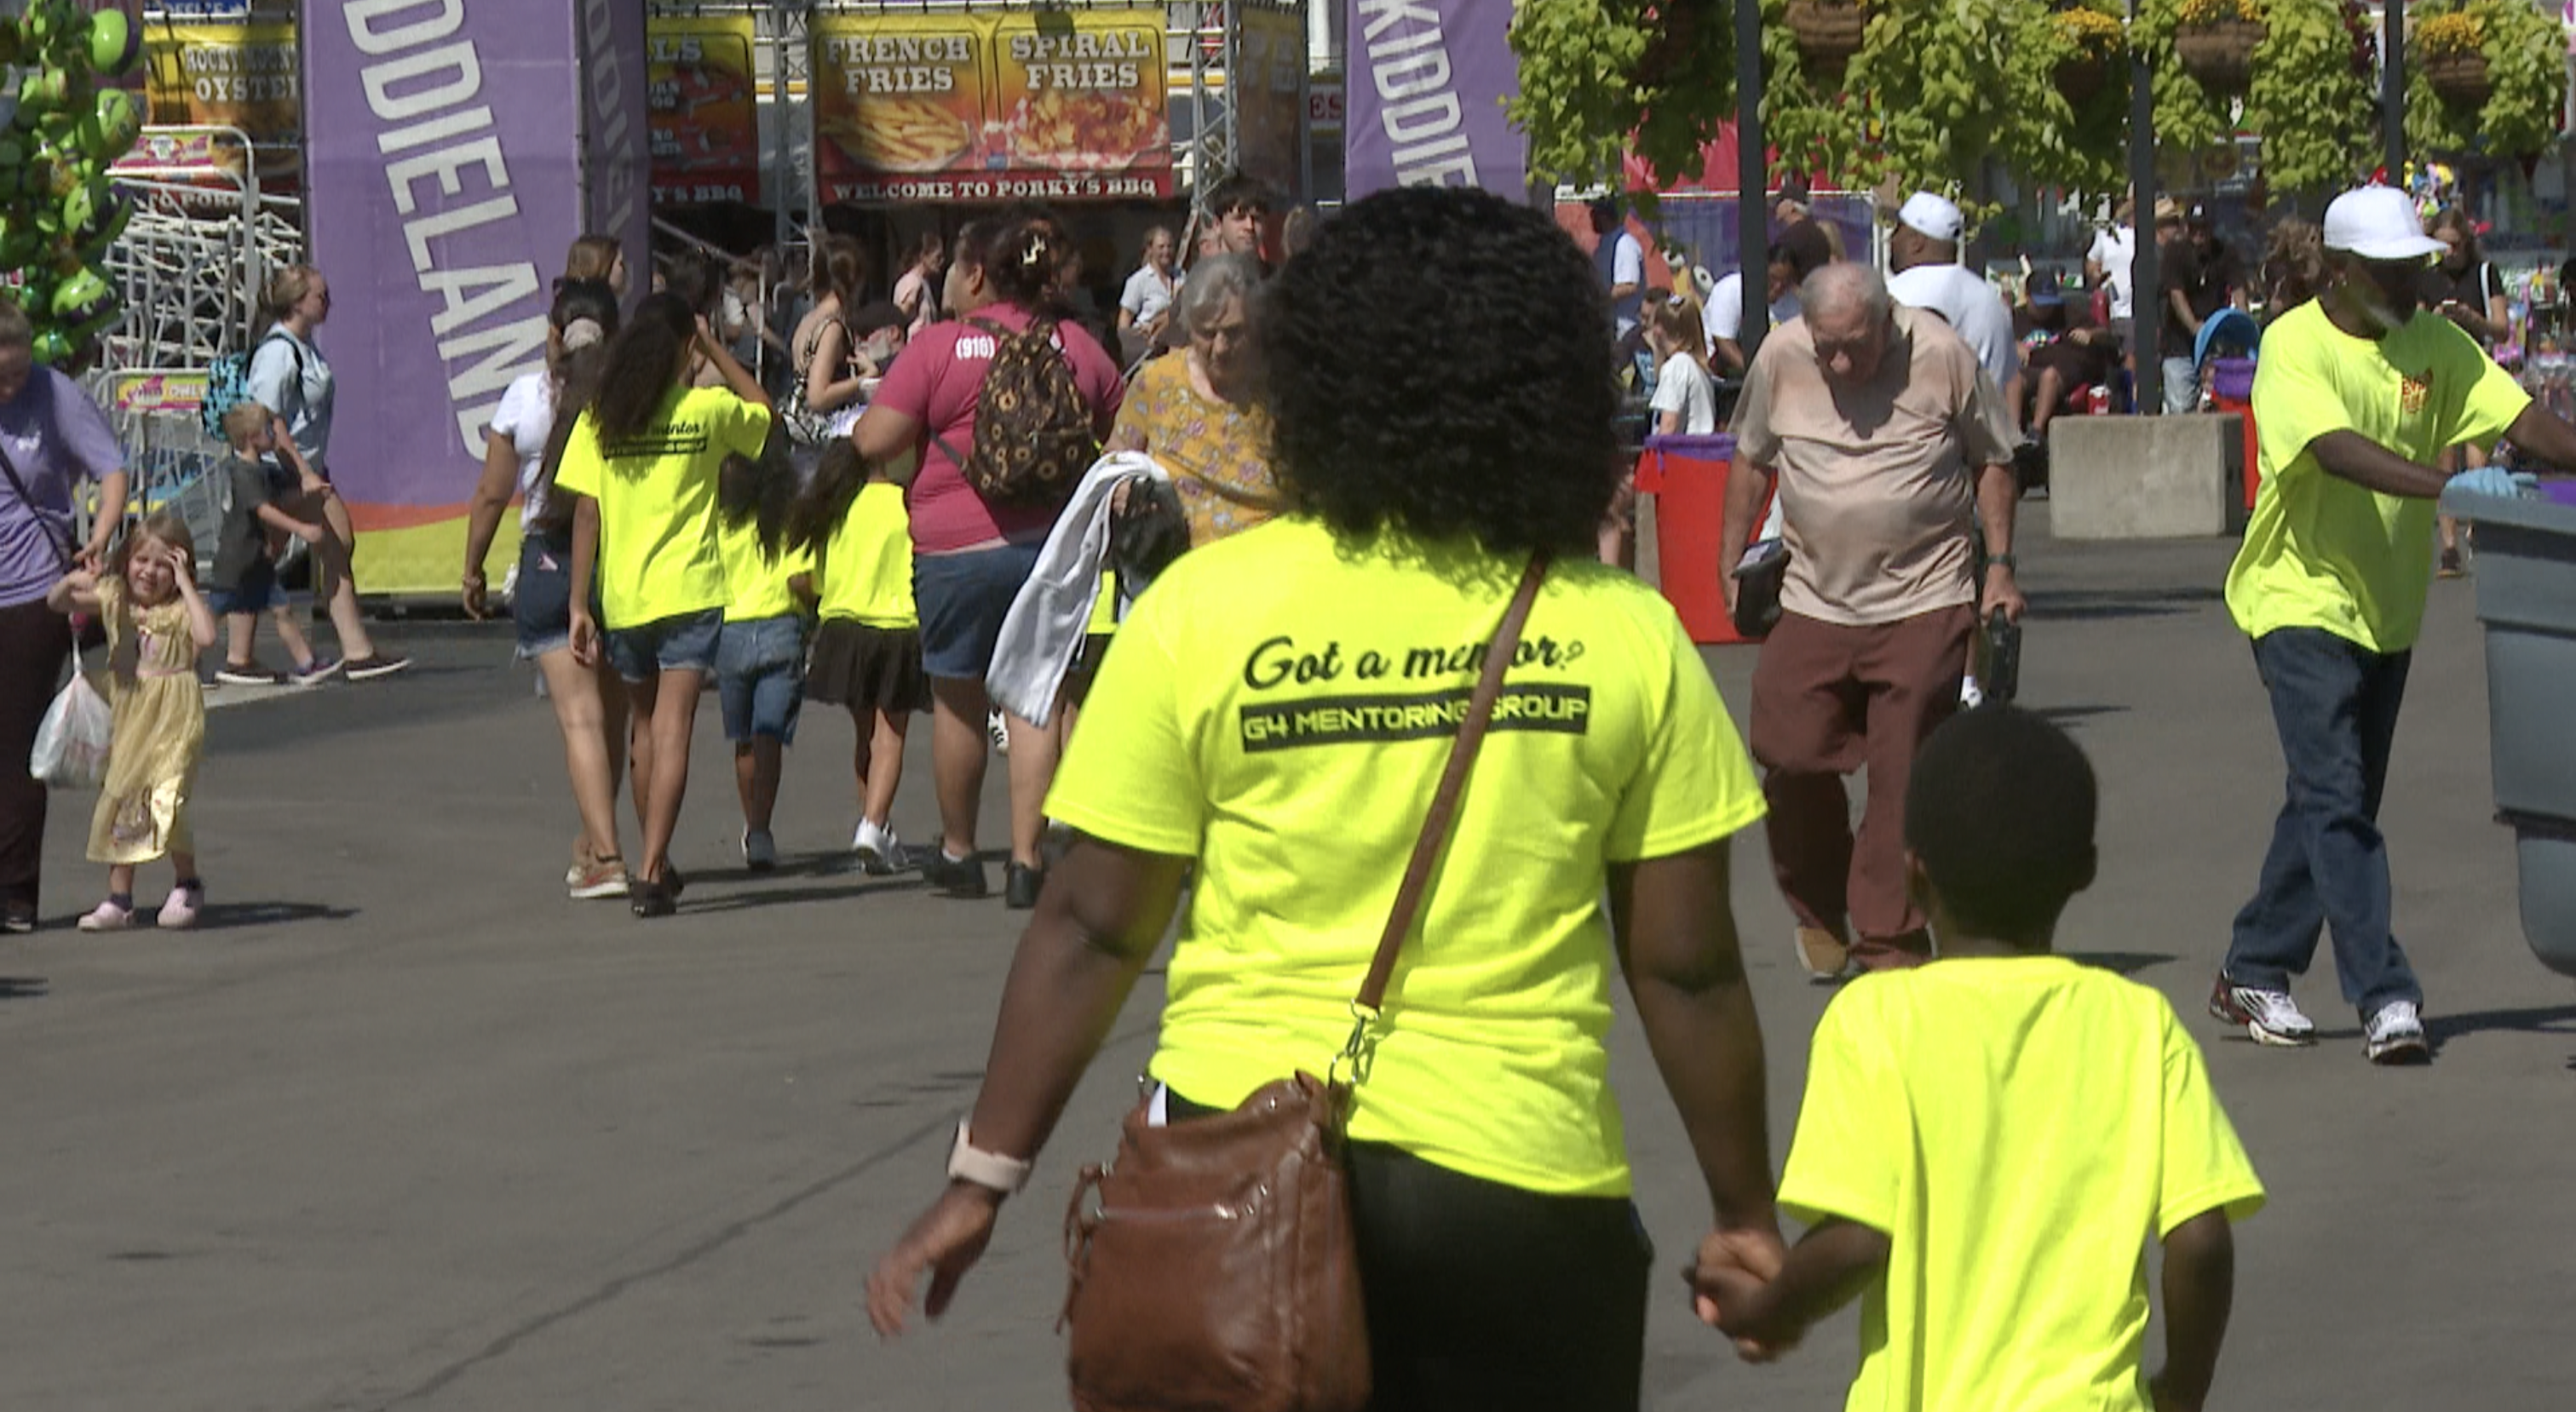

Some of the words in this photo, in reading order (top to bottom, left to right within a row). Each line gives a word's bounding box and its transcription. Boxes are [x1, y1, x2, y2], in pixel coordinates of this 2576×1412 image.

[184, 46, 239, 72] ROCKY
[825, 36, 970, 64] FRENCH
[1010, 31, 1150, 60] SPIRAL
[844, 66, 953, 94] FRIES
[1026, 63, 1140, 89] FRIES
[832, 181, 954, 200] WELCOME
[957, 181, 991, 198] TO
[996, 178, 1101, 198] PORKY'S
[1107, 177, 1157, 198] BBQ
[1244, 635, 1344, 690] Got
[1355, 650, 1393, 680] a
[1401, 635, 1585, 679] menor?
[1244, 714, 1289, 740] G4
